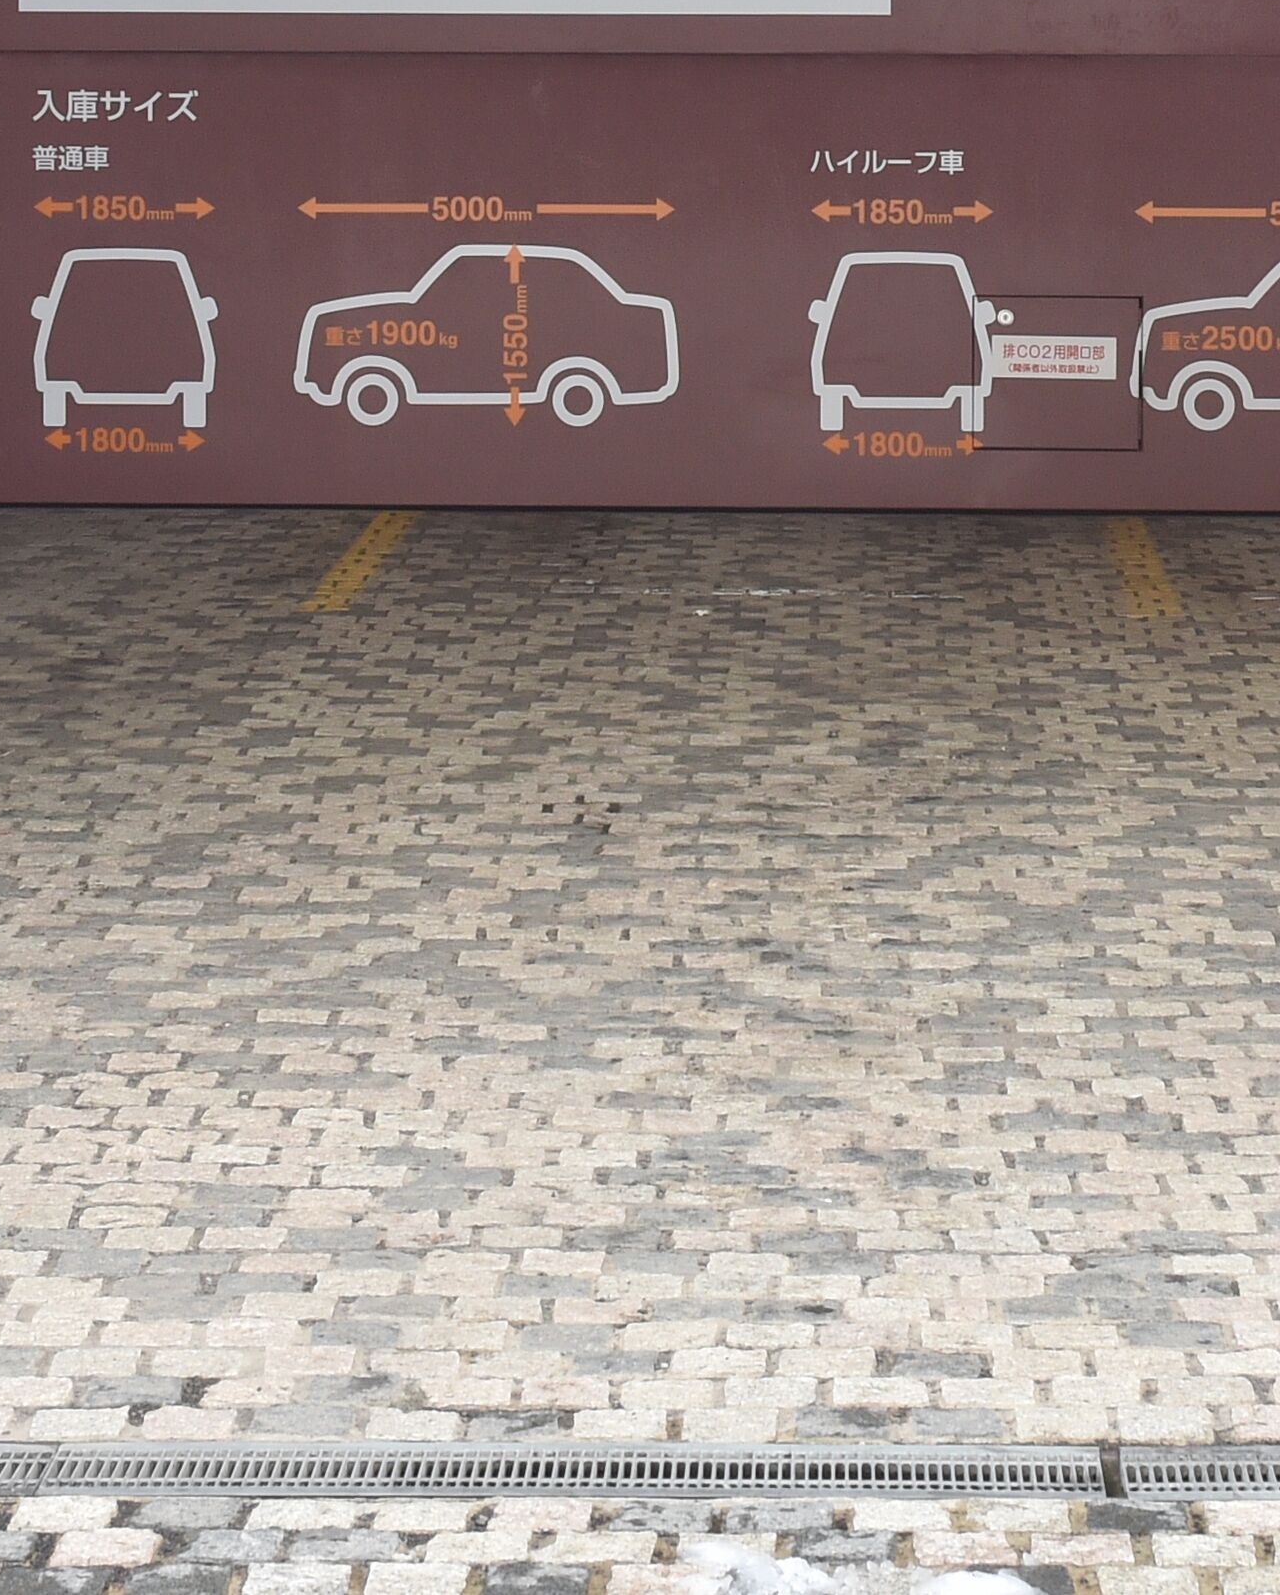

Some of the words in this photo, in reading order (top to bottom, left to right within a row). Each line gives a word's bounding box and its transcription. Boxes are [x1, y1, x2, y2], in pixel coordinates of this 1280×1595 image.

[32, 89, 200, 123] 入庫サイズ
[32, 145, 110, 171] 普通車
[810, 149, 965, 175] ハイルーフ車
[75, 196, 175, 222] 1850mm
[431, 197, 533, 223] 5000mm
[852, 198, 953, 226] 1850mm
[75, 427, 174, 454] 1800mm
[853, 431, 953, 458] 1800mm
